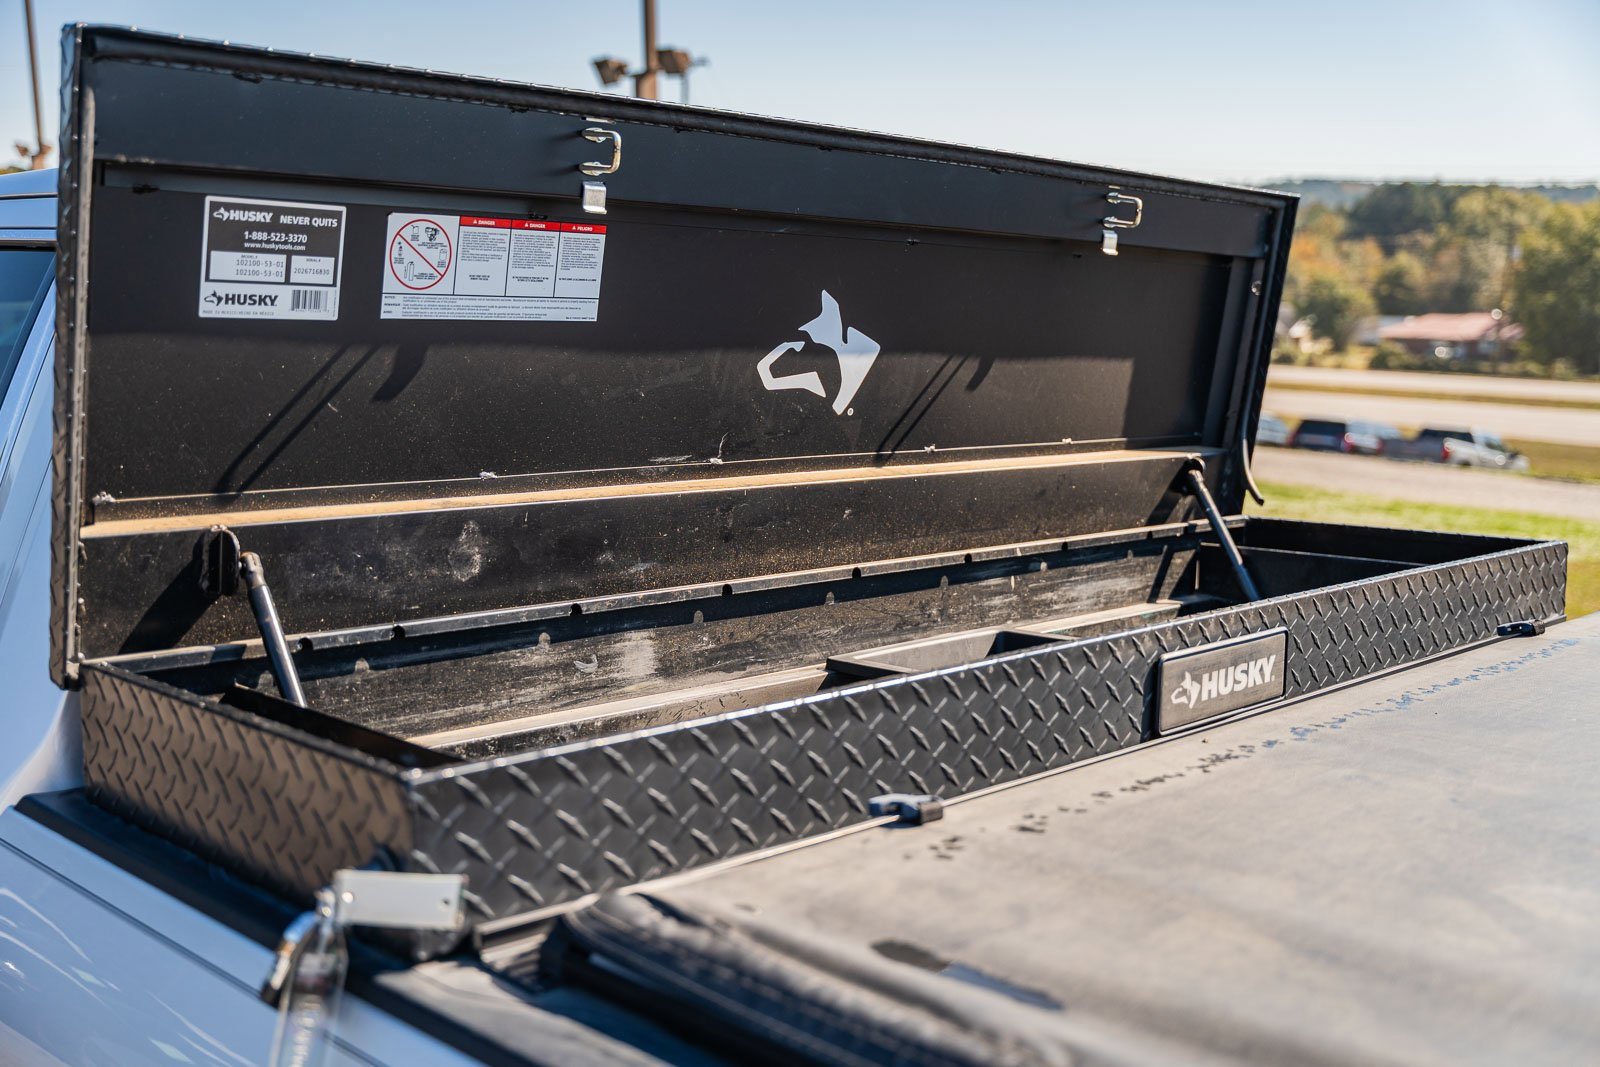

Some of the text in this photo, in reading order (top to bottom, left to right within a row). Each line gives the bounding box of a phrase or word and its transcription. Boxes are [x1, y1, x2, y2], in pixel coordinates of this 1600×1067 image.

[229, 209, 338, 228] HUSKY NEVER QUITS
[244, 231, 308, 243] 1-888-523-3370
[244, 241, 306, 251] www.huskytools.com
[236, 259, 284, 268] 102100-53-01
[235, 268, 283, 278] 102100-53-01
[224, 293, 279, 306] HUSKY
[1201, 655, 1276, 701] HUSKY
